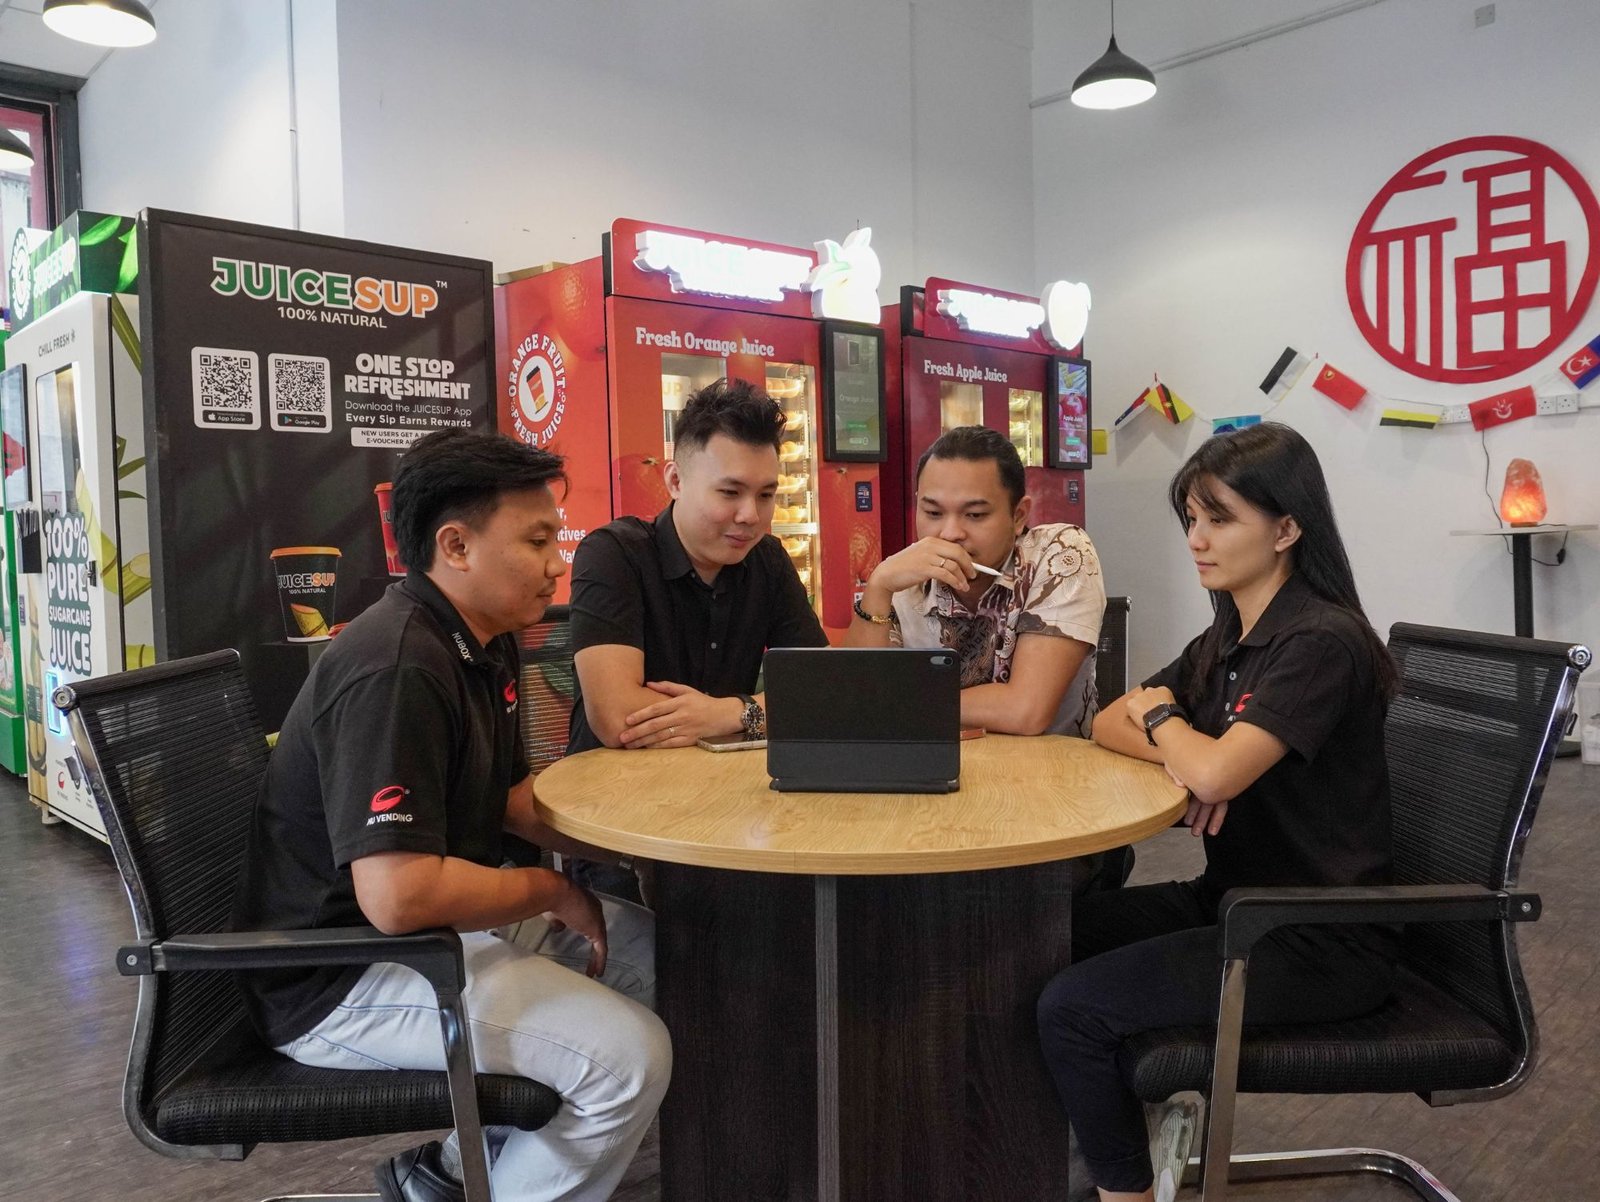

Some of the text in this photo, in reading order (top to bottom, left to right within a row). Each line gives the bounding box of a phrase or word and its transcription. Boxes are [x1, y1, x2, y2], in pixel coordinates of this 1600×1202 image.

[210, 256, 438, 319] JUICESUP
[277, 306, 388, 329] 100% NATURAL
[53, 332, 71, 351] FRESH
[635, 326, 775, 357] Fresh Orange Juice
[355, 352, 455, 379] ONE STOP
[508, 333, 566, 397] ORANGE FRUIT
[924, 359, 1008, 383] Fresh Apple Juice
[344, 374, 471, 400] REFRESHMENT
[345, 400, 472, 417] Download the JUICESUP App
[345, 413, 472, 427] Every Sip Earns Rewards
[511, 401, 565, 447] FRESH JUICE
[45, 516, 88, 558] 100%
[47, 562, 89, 602] PURE
[49, 606, 91, 627] SUGARCANE
[50, 627, 91, 671] JUICE
[452, 631, 472, 660] NUBOX
[375, 812, 413, 823] VENDING
